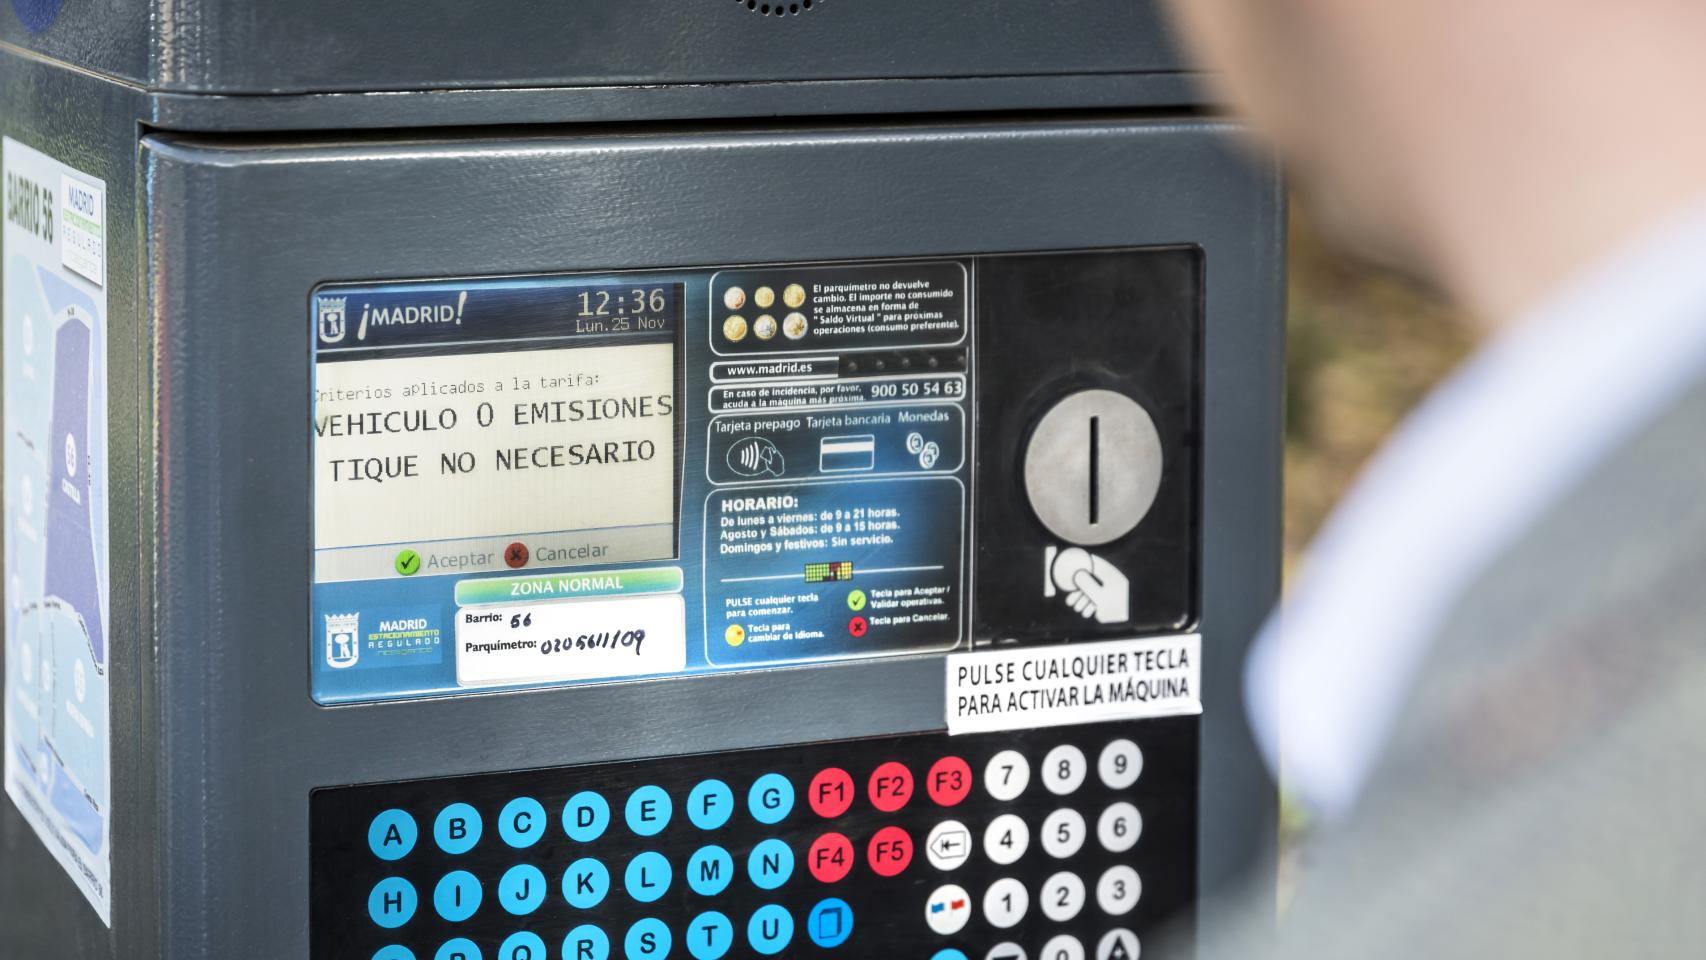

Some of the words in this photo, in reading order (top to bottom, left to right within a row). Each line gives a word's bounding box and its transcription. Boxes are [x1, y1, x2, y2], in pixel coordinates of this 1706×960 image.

[8, 170, 40, 236] BARRIO
[42, 187, 54, 245] 56
[68, 184, 94, 217] MADRID
[813, 284, 822, 293] El
[892, 280, 930, 289] devuelve
[576, 288, 665, 317] 12:36
[813, 294, 847, 304] cambio.
[849, 293, 857, 302] El
[859, 292, 893, 302] importe
[907, 289, 954, 299] consumido
[813, 306, 824, 314] se
[826, 304, 866, 313] almacena
[881, 302, 906, 311] forma
[909, 301, 919, 310] de
[638, 316, 666, 329] Nov
[883, 314, 902, 322] para
[813, 325, 866, 336] operaciones
[868, 323, 908, 333] (consumo
[727, 363, 813, 375] www.madrid.es
[402, 381, 485, 398] aplicados
[495, 382, 504, 392] a
[512, 376, 531, 392] la
[540, 374, 600, 389] tarifa:
[723, 390, 734, 398] En
[759, 389, 769, 397] de
[772, 387, 818, 396] incidencia,
[820, 386, 834, 395] por
[871, 384, 897, 397] 900
[901, 383, 919, 395] 50
[923, 382, 940, 394] 54
[944, 381, 962, 394] 63
[723, 400, 749, 409] acuda
[759, 399, 767, 407] la
[769, 398, 807, 408] máquina
[315, 408, 457, 437] VEHICULO
[514, 394, 673, 426] EMISIONES
[806, 416, 843, 429] Tarjeta
[845, 413, 891, 426] bancaria
[898, 410, 949, 423] Monedas
[715, 421, 751, 434] Tarjeta
[754, 419, 801, 433] prepago
[329, 455, 419, 483] TIQUE
[440, 452, 476, 475] NO
[495, 439, 655, 472] NECESARIO
[721, 496, 798, 512] HORARIO:
[721, 517, 734, 527] De
[737, 514, 765, 526] lunes
[768, 516, 774, 524] a
[776, 513, 818, 523] viernes:
[820, 511, 833, 521] de
[835, 510, 842, 520] 9
[853, 508, 865, 519] 21
[868, 507, 900, 518] horas.
[720, 529, 758, 541] Agosto
[760, 529, 766, 538] y
[769, 525, 818, 536] Sábados:
[820, 523, 833, 533] de
[835, 522, 842, 533] 9
[854, 521, 865, 531] 15
[868, 520, 900, 531] horas.
[720, 542, 772, 554] Domingos
[775, 543, 782, 553] y
[784, 539, 828, 550] festivos:
[831, 537, 847, 547] Sin
[850, 534, 893, 545] servicio.
[427, 551, 496, 570] Aceptar
[535, 543, 609, 562] Cancelar
[511, 579, 553, 596] ZONA
[558, 575, 623, 593] NORMAL
[870, 589, 892, 598] Tecla
[894, 588, 912, 597] para
[914, 587, 945, 595] Aceptar
[726, 597, 753, 608] PULSE
[755, 594, 796, 606] cualquier
[797, 593, 819, 603] tecla
[870, 600, 899, 609] Validar
[901, 598, 944, 608] operativas.
[465, 612, 503, 625] Barrio:
[510, 613, 532, 629] 56
[726, 610, 746, 619] para
[748, 607, 794, 616] comenzar.
[870, 616, 891, 625] Tecla
[893, 615, 911, 625] para
[379, 619, 427, 632] MADRID
[747, 624, 770, 633] Tecla
[771, 623, 790, 632] para
[368, 637, 440, 649] REGULADO
[748, 633, 782, 642] cambiar
[782, 631, 794, 640] de
[465, 639, 537, 654] Parquímetro:
[958, 662, 1015, 687] PULSE
[1022, 652, 1128, 681] CUALQUIER
[1133, 648, 1190, 672] TECLA
[958, 693, 1002, 717] PARA
[1007, 686, 1080, 712] ACTIVAR
[1084, 684, 1104, 705] LA
[1109, 676, 1190, 703] MÁQUINA
[1001, 766, 1014, 785] 7
[1058, 760, 1072, 779] 8
[1114, 754, 1127, 773] 9
[818, 781, 846, 803] F1
[876, 776, 905, 797] F2
[936, 770, 963, 791] F3
[382, 824, 403, 847] A
[449, 818, 466, 840] B
[512, 812, 533, 834] C
[577, 806, 595, 828] D
[641, 800, 656, 822] E
[703, 794, 717, 815] F
[762, 788, 781, 810] G
[1000, 829, 1014, 849] 4
[1057, 823, 1071, 843] 5
[1113, 817, 1127, 837] 6
[816, 847, 845, 868] F4
[876, 841, 904, 863] F5
[383, 892, 401, 914] H
[515, 879, 530, 901] J
[577, 872, 595, 895] K
[641, 867, 656, 888] L
[700, 860, 720, 882] M
[762, 853, 780, 874] N
[1002, 893, 1012, 912] 1
[1057, 887, 1070, 906] 2
[1113, 880, 1126, 899] 3
[577, 939, 595, 960] R
[640, 932, 656, 954] S
[702, 925, 719, 947] T
[762, 919, 779, 940] U
